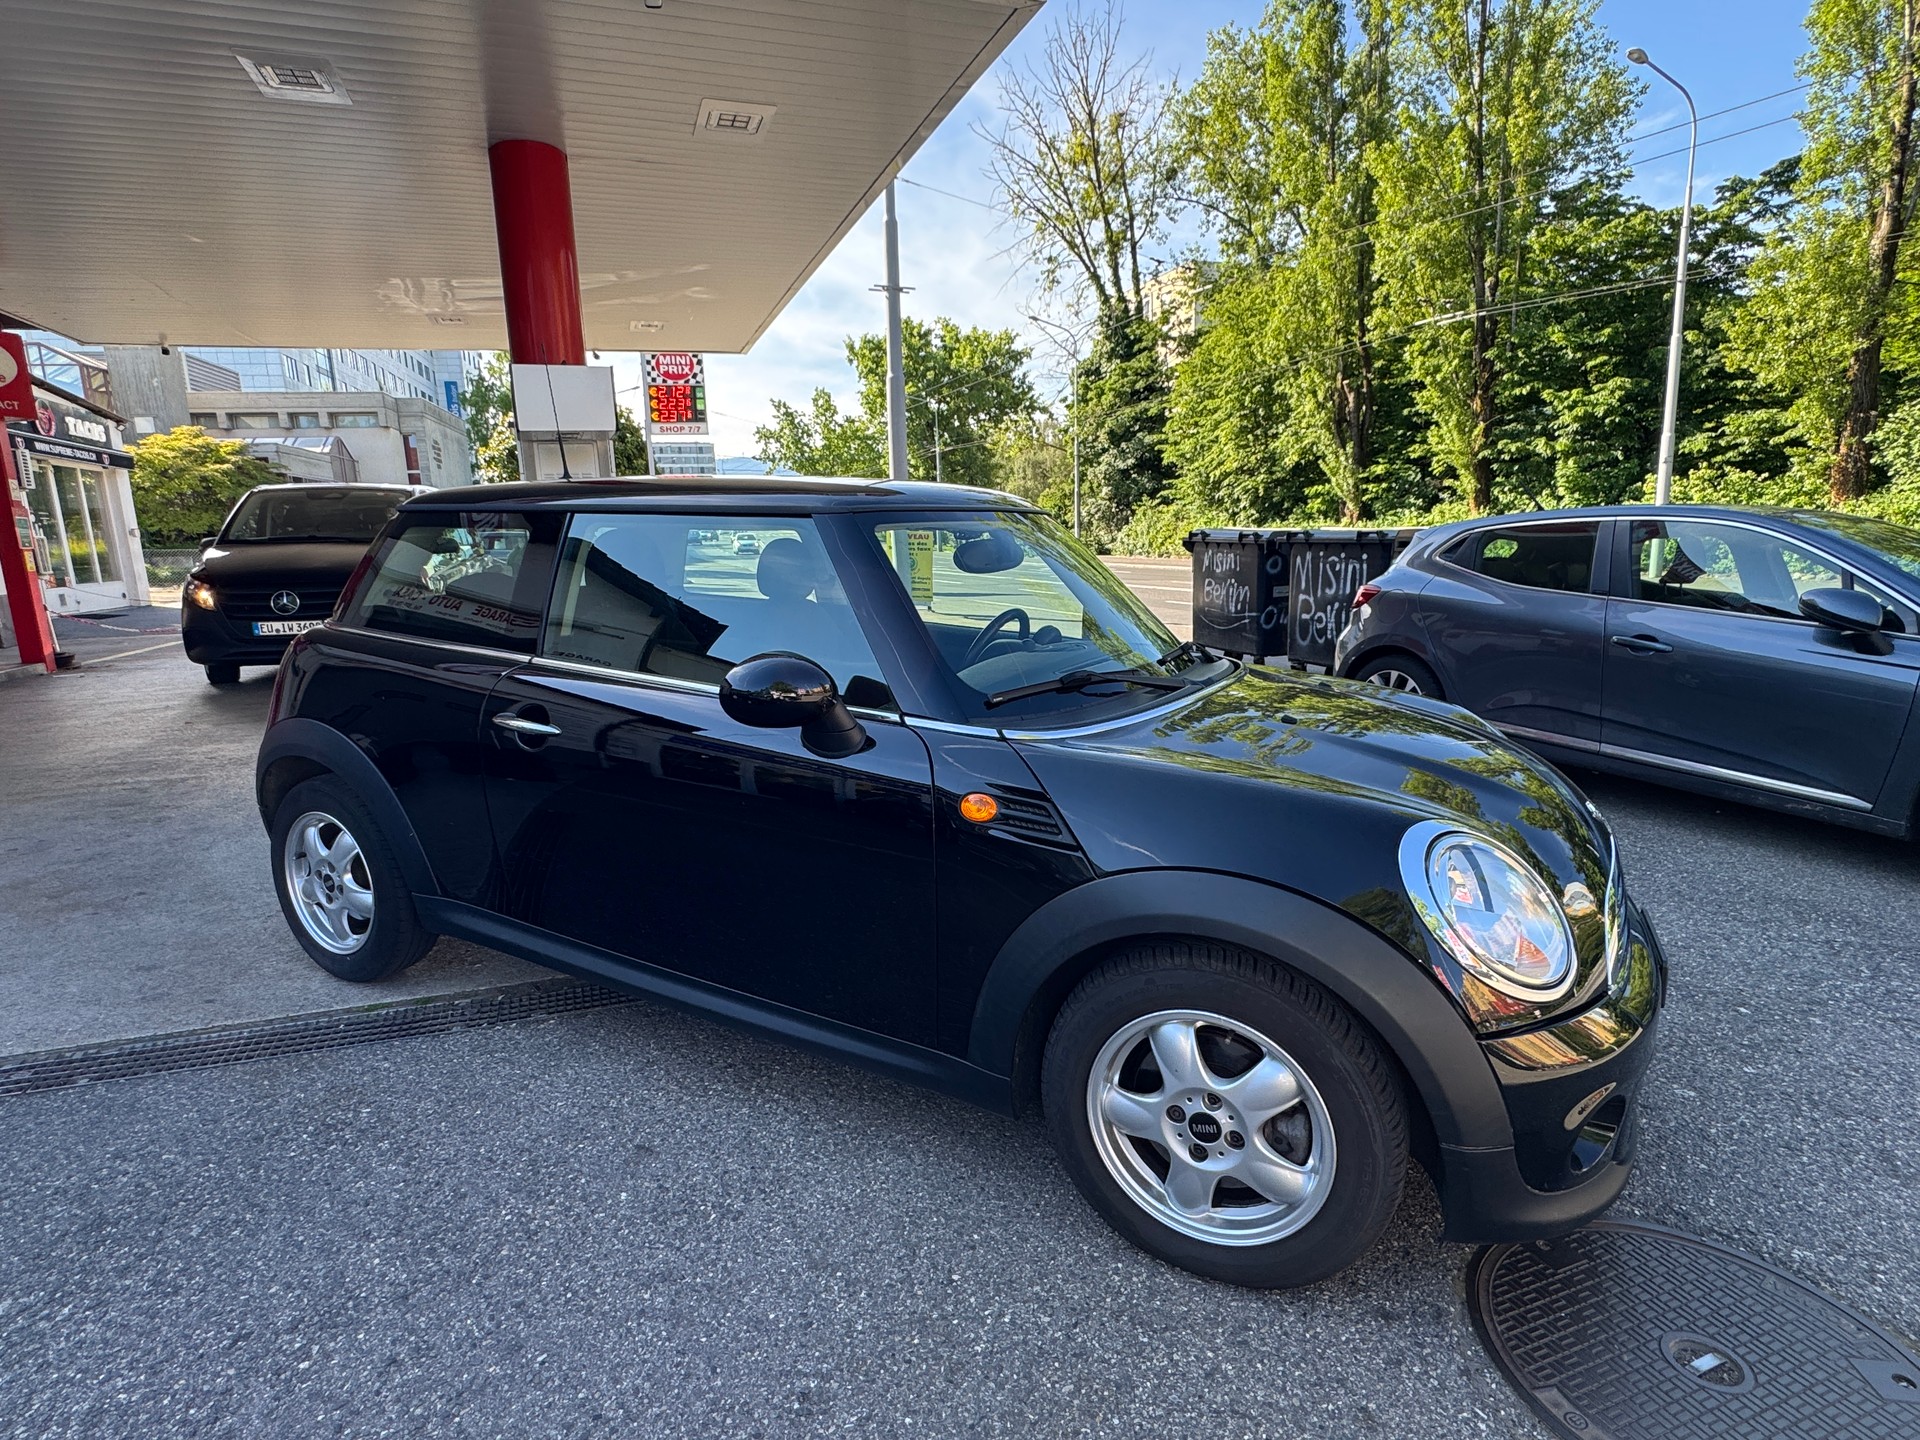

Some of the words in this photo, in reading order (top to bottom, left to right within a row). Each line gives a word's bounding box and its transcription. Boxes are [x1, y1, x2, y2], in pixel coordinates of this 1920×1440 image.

[659, 355, 691, 365] MINI
[659, 365, 692, 375] PRIX
[64, 416, 107, 442] TACOS
[1192, 1123, 1218, 1134] MINI
